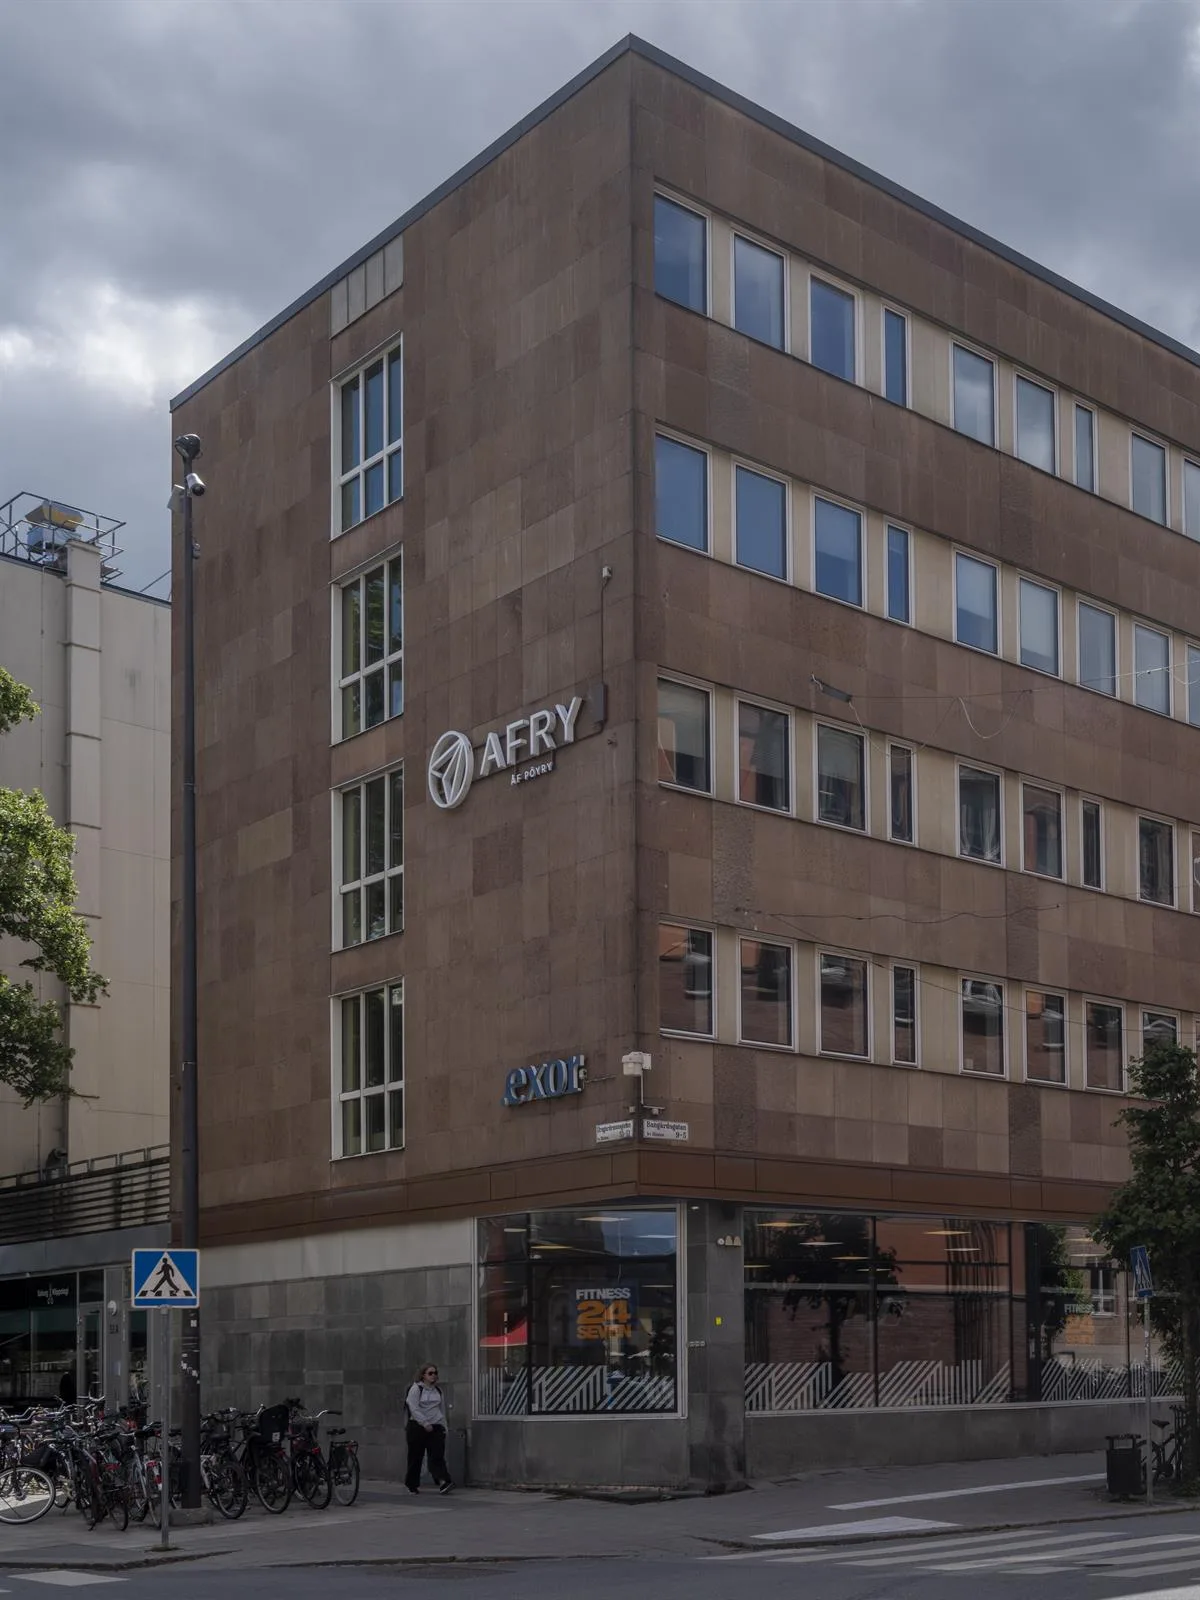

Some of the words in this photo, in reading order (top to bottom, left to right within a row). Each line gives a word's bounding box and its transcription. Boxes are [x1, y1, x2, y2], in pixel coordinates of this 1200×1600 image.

[479, 695, 583, 776] AFRY
[510, 772, 523, 786] ÅF
[575, 1287, 632, 1300] FITNESS
[575, 1299, 632, 1325] 24
[1064, 1303, 1095, 1314] FITNESS
